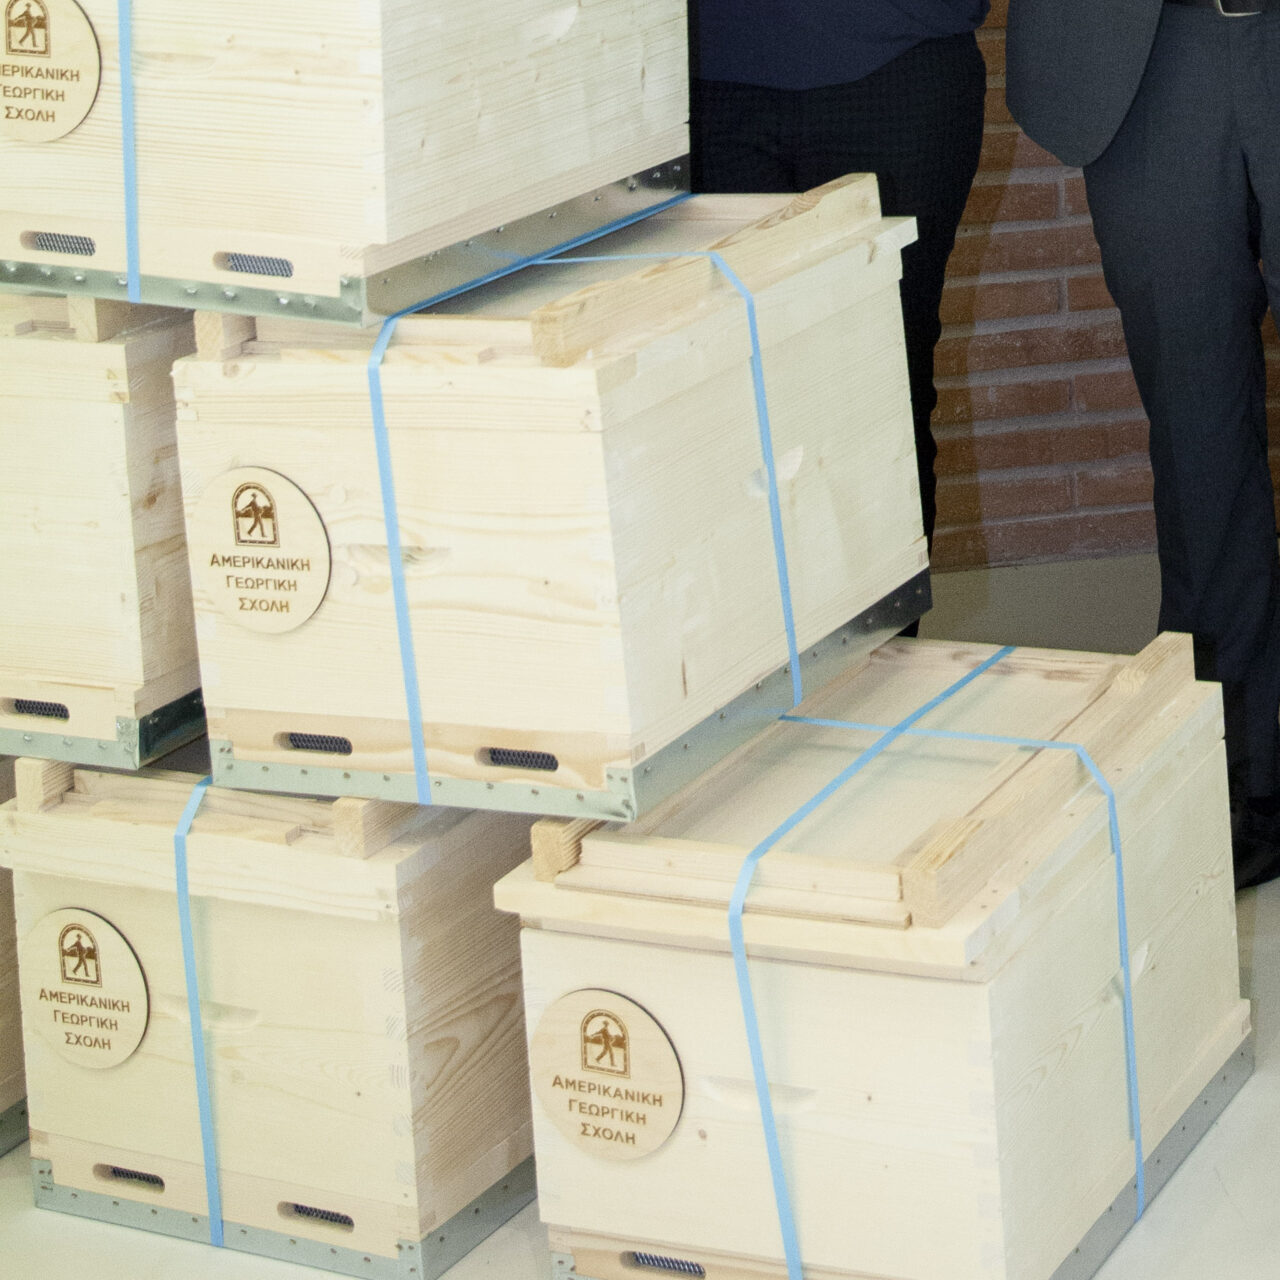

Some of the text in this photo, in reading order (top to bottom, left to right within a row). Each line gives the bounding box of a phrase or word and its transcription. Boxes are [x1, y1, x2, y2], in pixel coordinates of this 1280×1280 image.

[5, 106, 56, 122] ΣΧΟΛΗ
[210, 553, 311, 572] ΑΜΕΡΙΚΑΝΙΚΗ
[226, 575, 298, 592] ΓΕΩΡΓΙΚΗ
[238, 597, 290, 613] ΣΧΟΛΗ
[39, 988, 130, 1013] ΑΜΕΡΙΚΑΝΙΚΗ
[53, 1010, 119, 1031] ΓΕΩΡΓΙΚΗ
[65, 1032, 111, 1050] ΣΧΟΛΗ
[552, 1075, 662, 1106] ΑΜΕΡΙΚΑΝΙΚΗ
[568, 1098, 647, 1125] ΓΕΩΡΓΙΚΗ
[580, 1122, 636, 1145] ΣΧΟΛΗ
